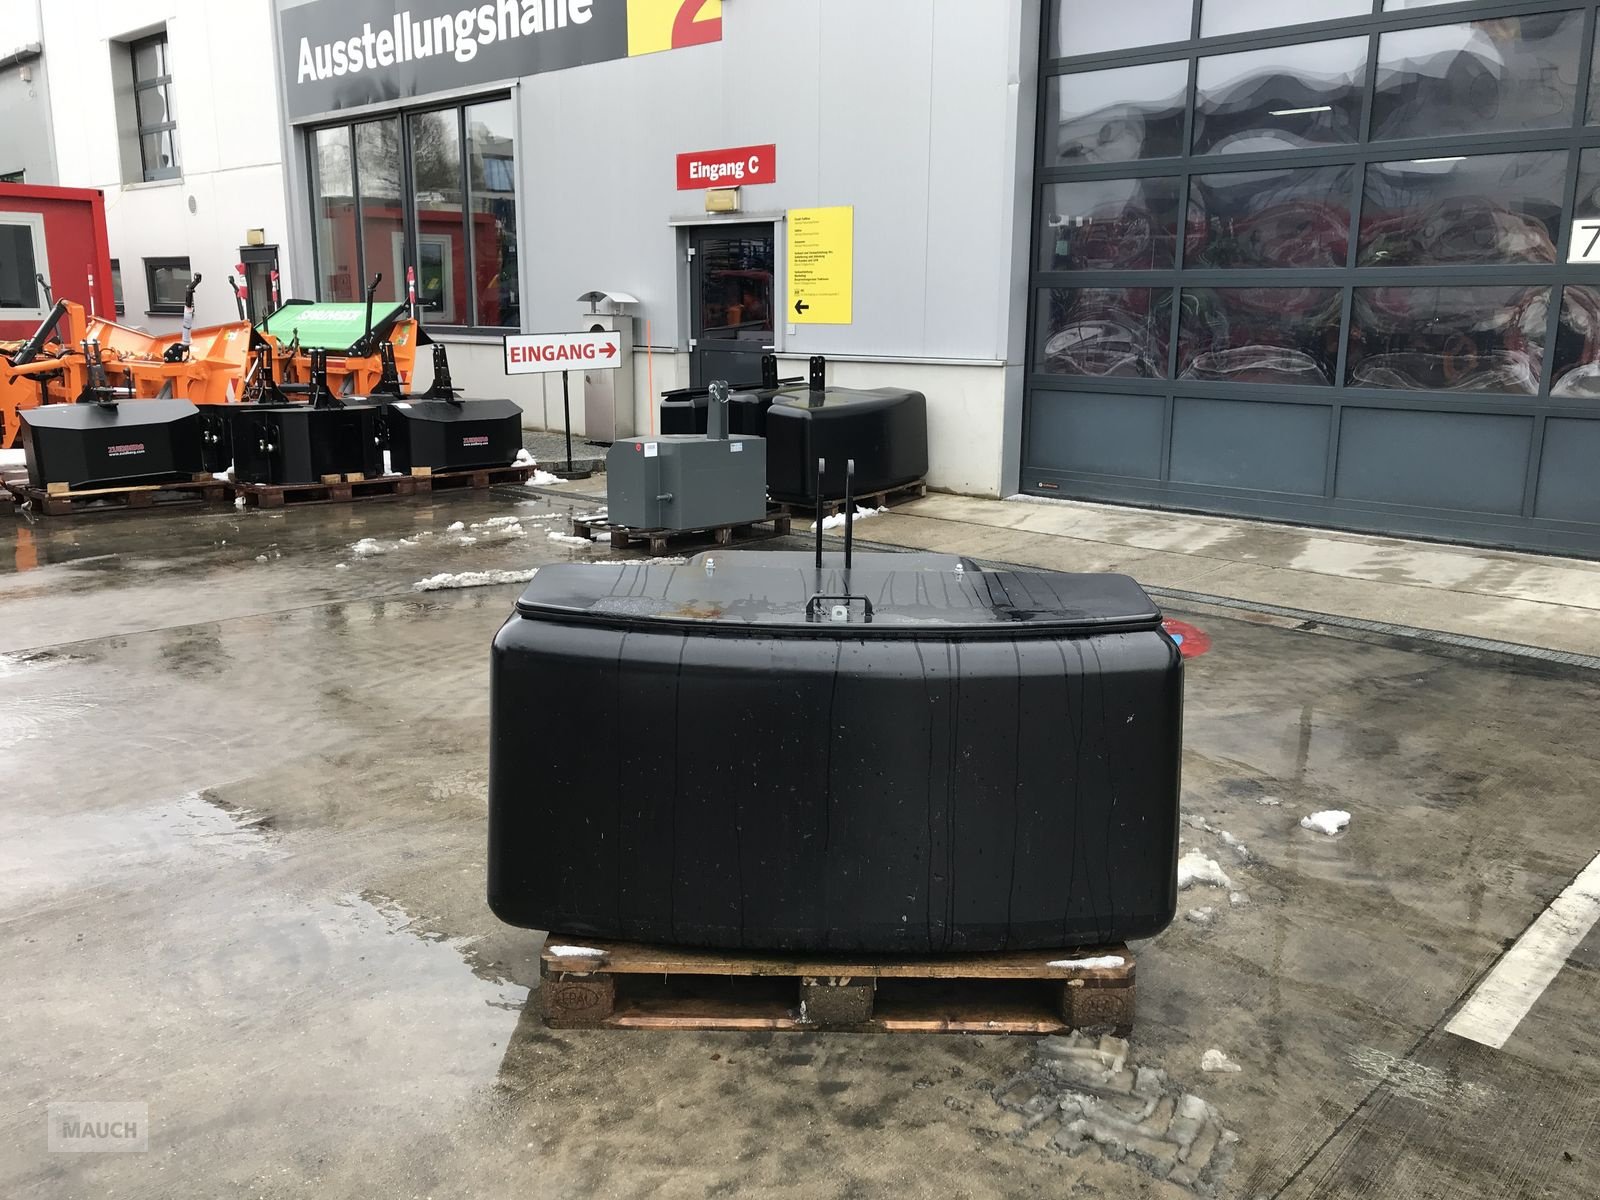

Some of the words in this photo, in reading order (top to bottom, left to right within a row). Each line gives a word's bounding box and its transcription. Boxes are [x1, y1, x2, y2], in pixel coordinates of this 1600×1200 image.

[689, 161, 745, 181] Eingang
[748, 155, 759, 174] C
[510, 343, 595, 363] EINGANG
